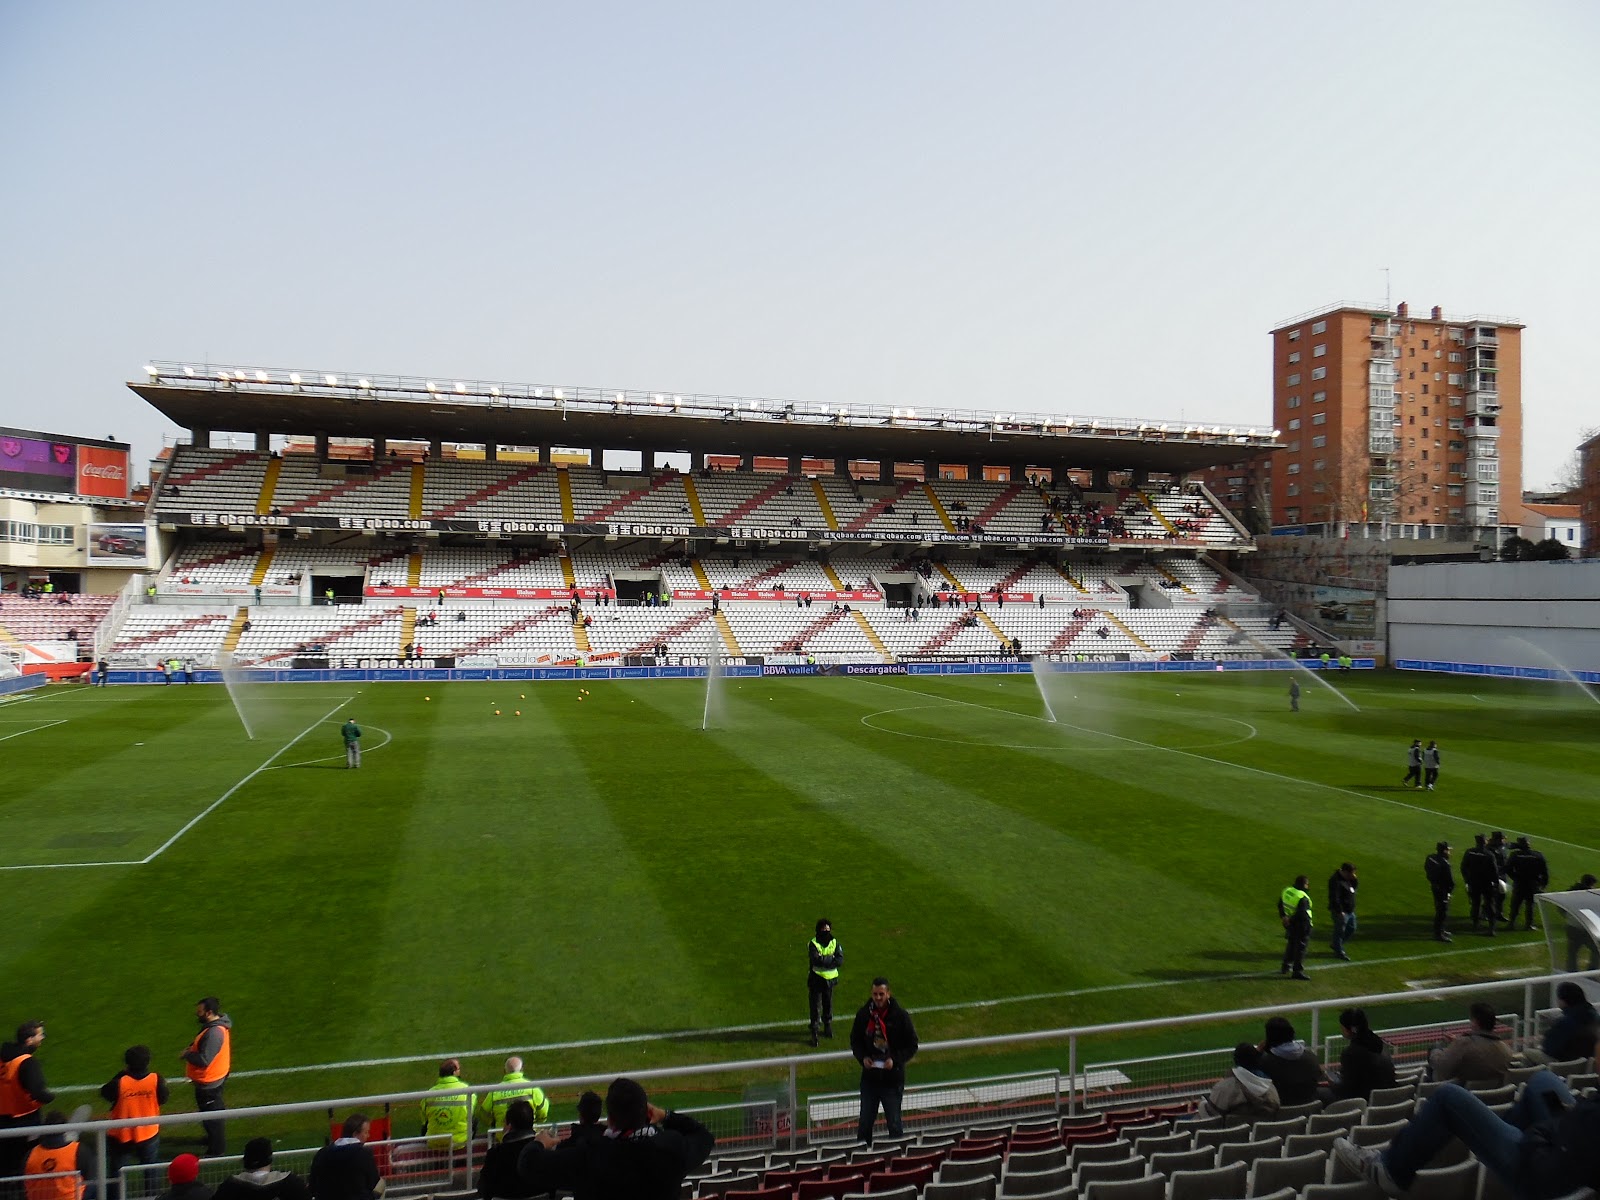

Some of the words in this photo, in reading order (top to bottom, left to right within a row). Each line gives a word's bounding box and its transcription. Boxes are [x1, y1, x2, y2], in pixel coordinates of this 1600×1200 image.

[220, 514, 289, 526] qbao.com
[366, 518, 432, 529] qbao.com
[504, 522, 564, 532] qbao.com
[633, 525, 689, 536] qbao.com
[754, 528, 807, 538] qbao.com
[498, 653, 535, 663] modalia
[763, 666, 786, 674] BBVA
[788, 666, 814, 674] wallet
